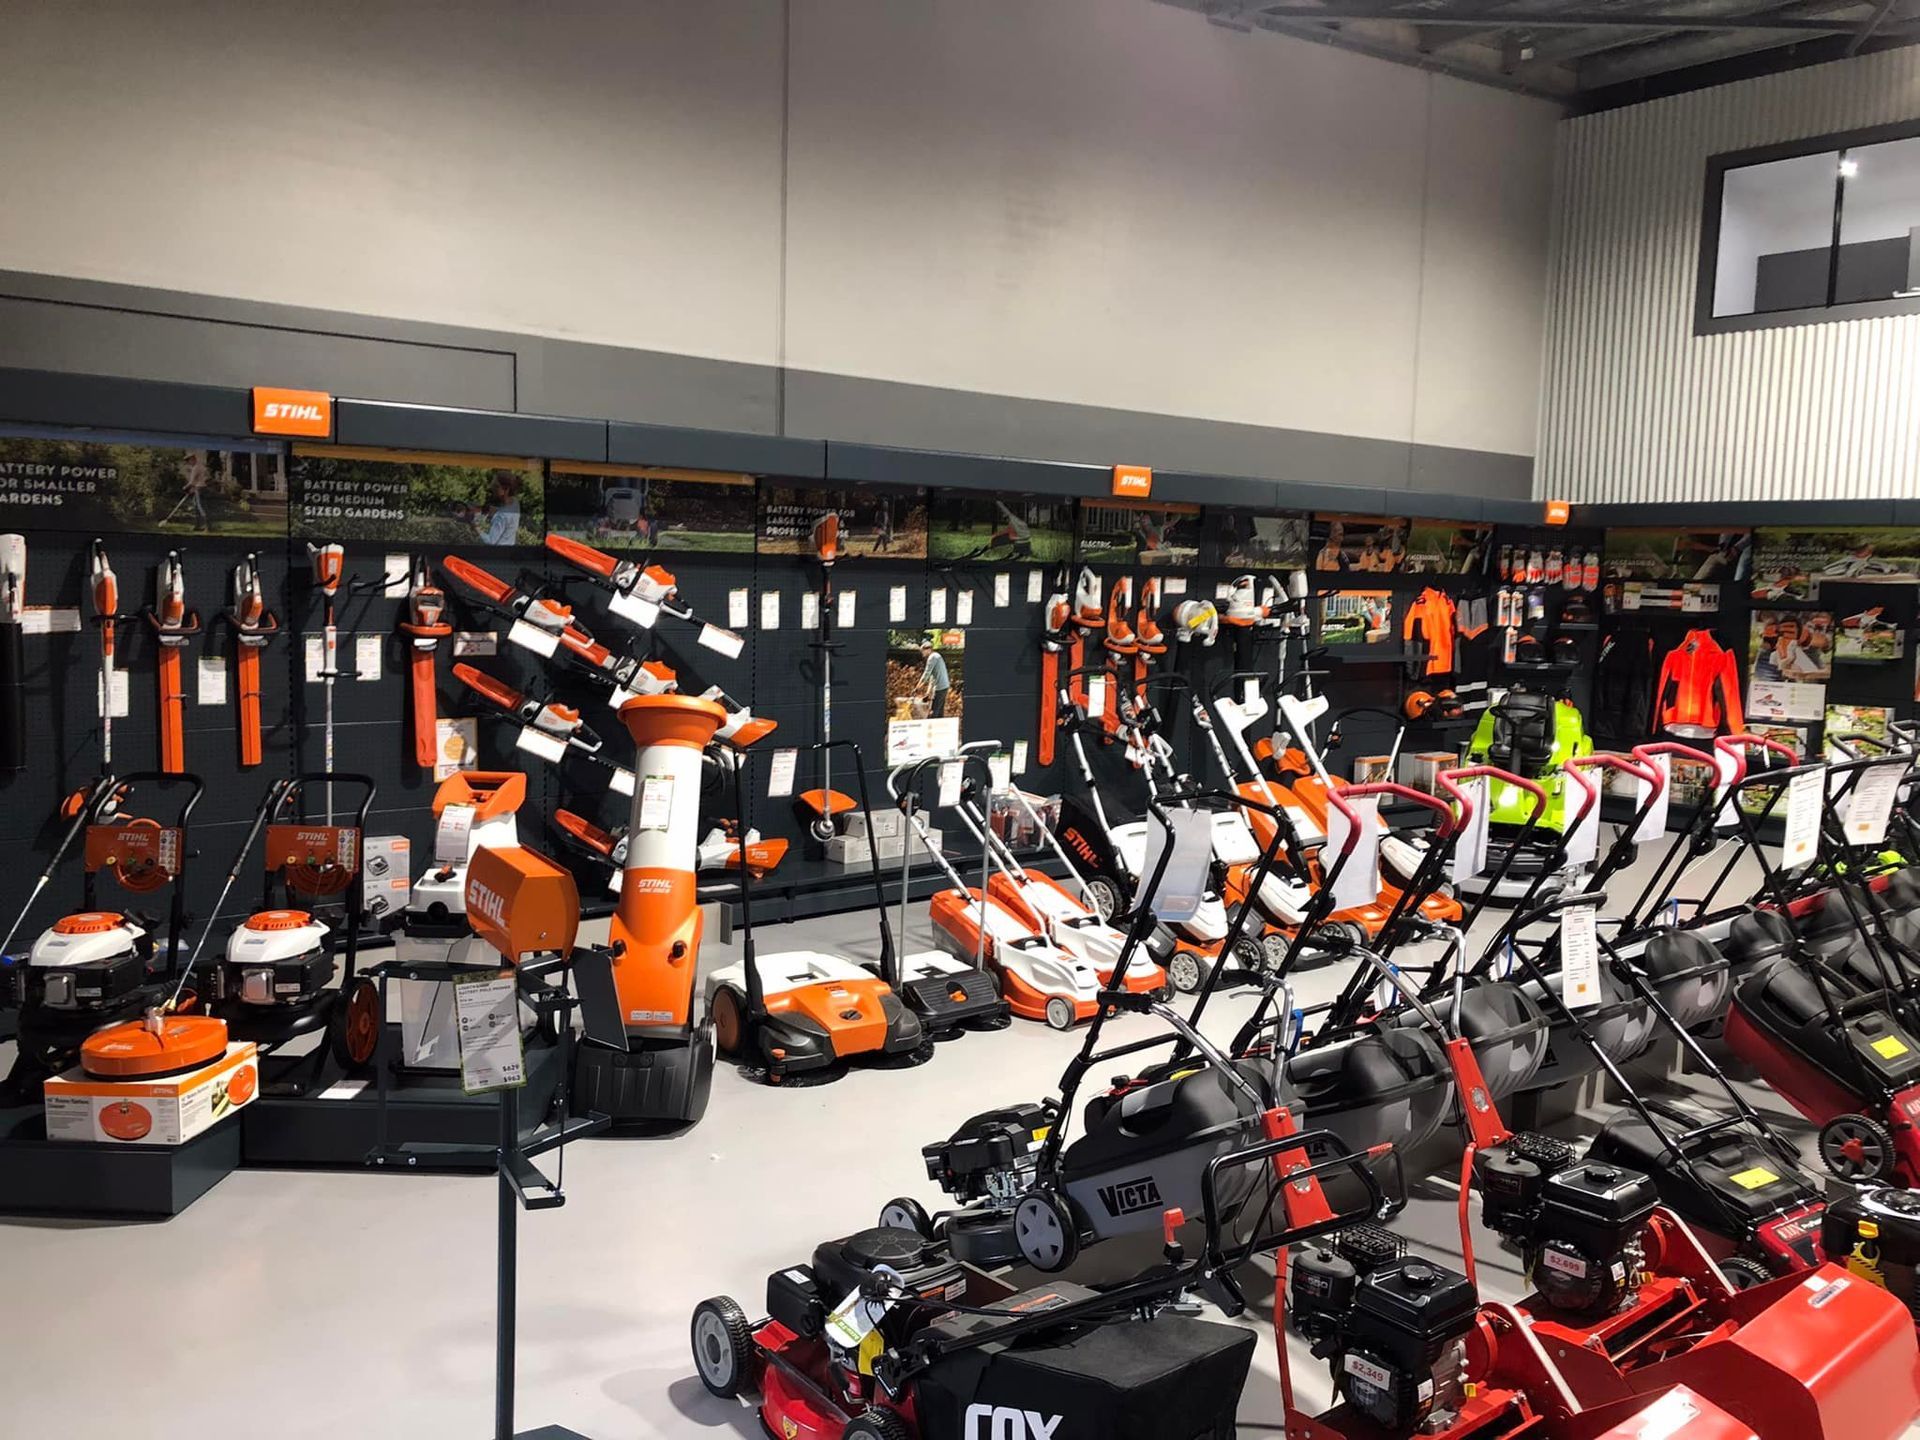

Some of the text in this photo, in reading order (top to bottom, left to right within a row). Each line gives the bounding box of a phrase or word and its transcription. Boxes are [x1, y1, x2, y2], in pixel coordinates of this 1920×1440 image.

[264, 403, 323, 421] STIHL
[0, 462, 118, 479] ATTERY POWER
[0, 477, 97, 493] OR SMALLER
[303, 479, 408, 494] BATTERY POWER
[1120, 475, 1148, 487] STIHL
[0, 492, 64, 506] ARDENS
[303, 493, 385, 506] FOR MEDIUM
[304, 505, 405, 520] SIZED GARDENS
[766, 505, 804, 515] BATTERY
[766, 516, 796, 525] LARGE
[117, 833, 150, 842] STIHL
[297, 832, 329, 841] STIHL
[1063, 827, 1099, 868] STIHL
[638, 879, 672, 888] STIHL
[469, 879, 506, 928] STIHL
[1097, 1181, 1162, 1217] VICTA
[1352, 1360, 1384, 1382] $2,349
[965, 1403, 1064, 1440] COX
